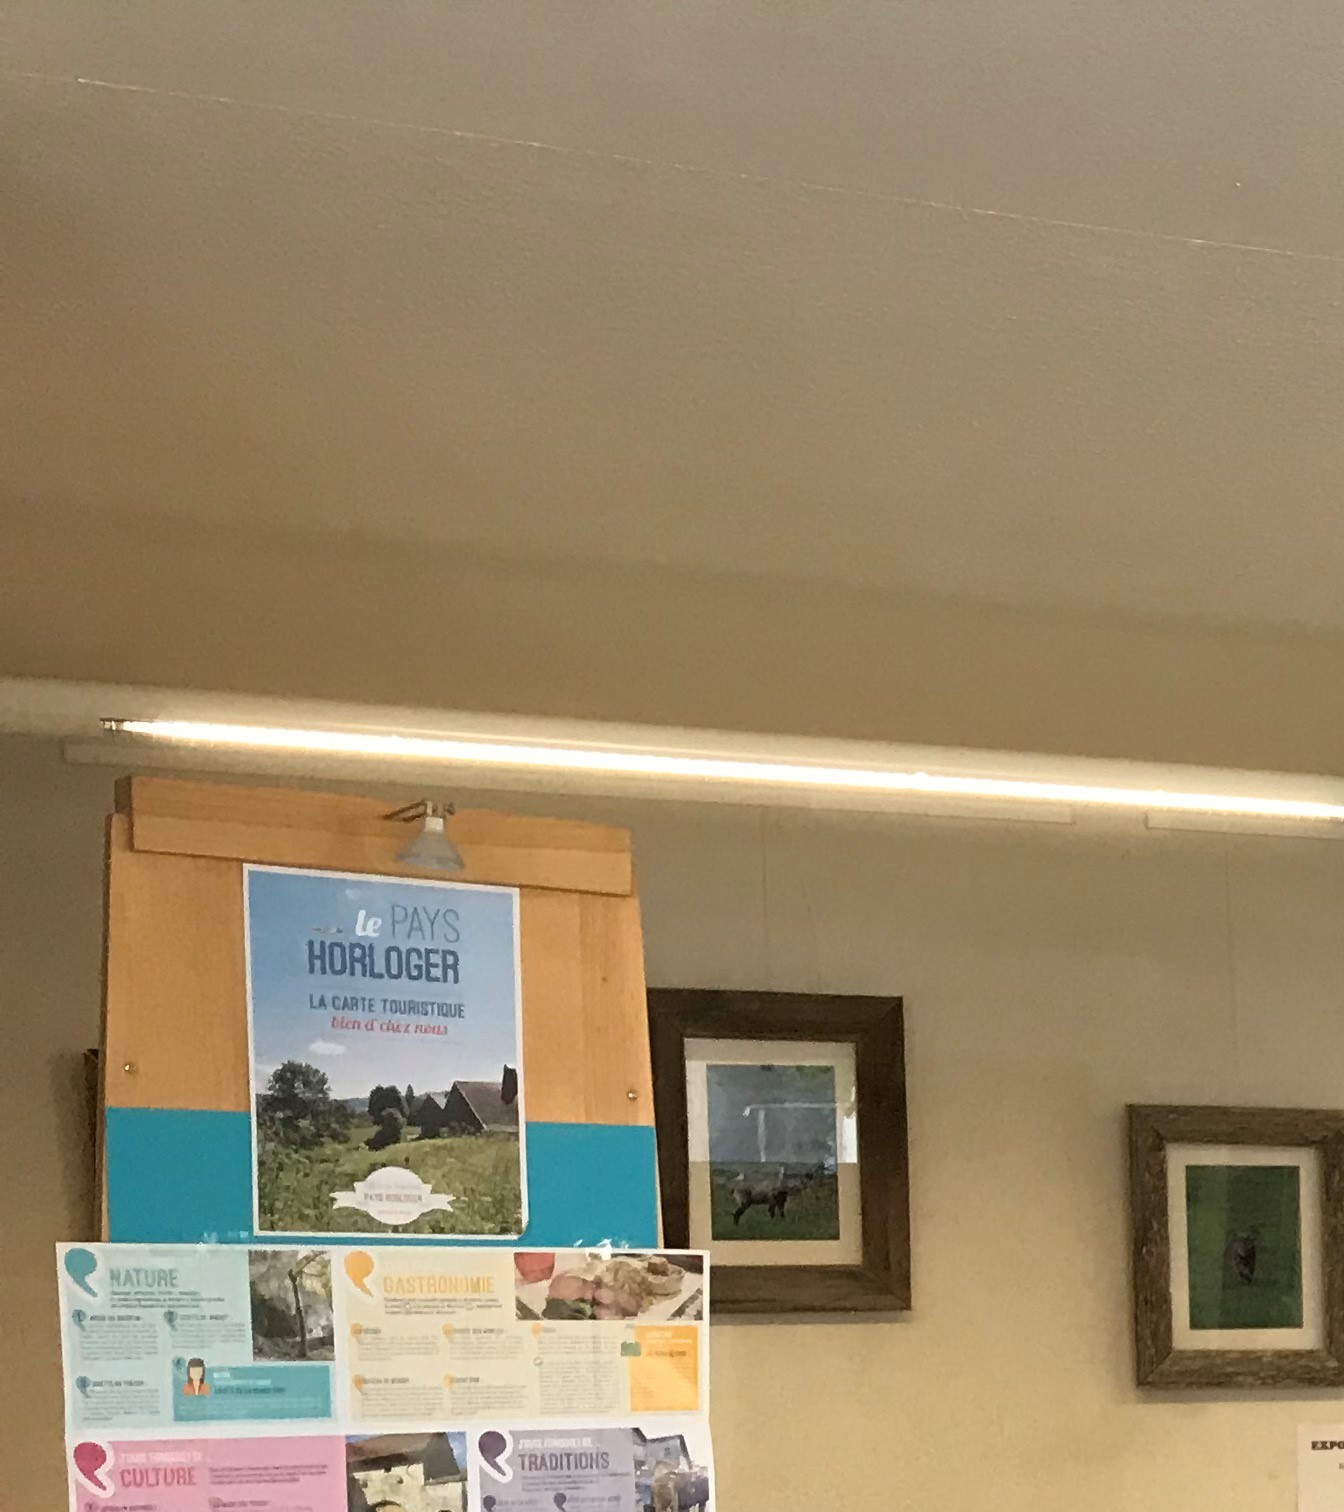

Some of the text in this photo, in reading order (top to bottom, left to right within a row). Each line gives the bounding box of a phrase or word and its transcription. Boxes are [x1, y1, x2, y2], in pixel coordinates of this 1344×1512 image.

[355, 904, 460, 943] le PAYS
[307, 939, 460, 984] HORLOGER
[309, 994, 466, 1018] LA CARTE TOURISTIQUE
[331, 1015, 361, 1031] bien
[414, 1024, 448, 1036] nous
[109, 1268, 179, 1288] NATURE
[383, 1275, 495, 1294] GASTRONOMIE
[517, 1451, 610, 1471] TRADITIONS
[120, 1467, 198, 1488] CULTURE
